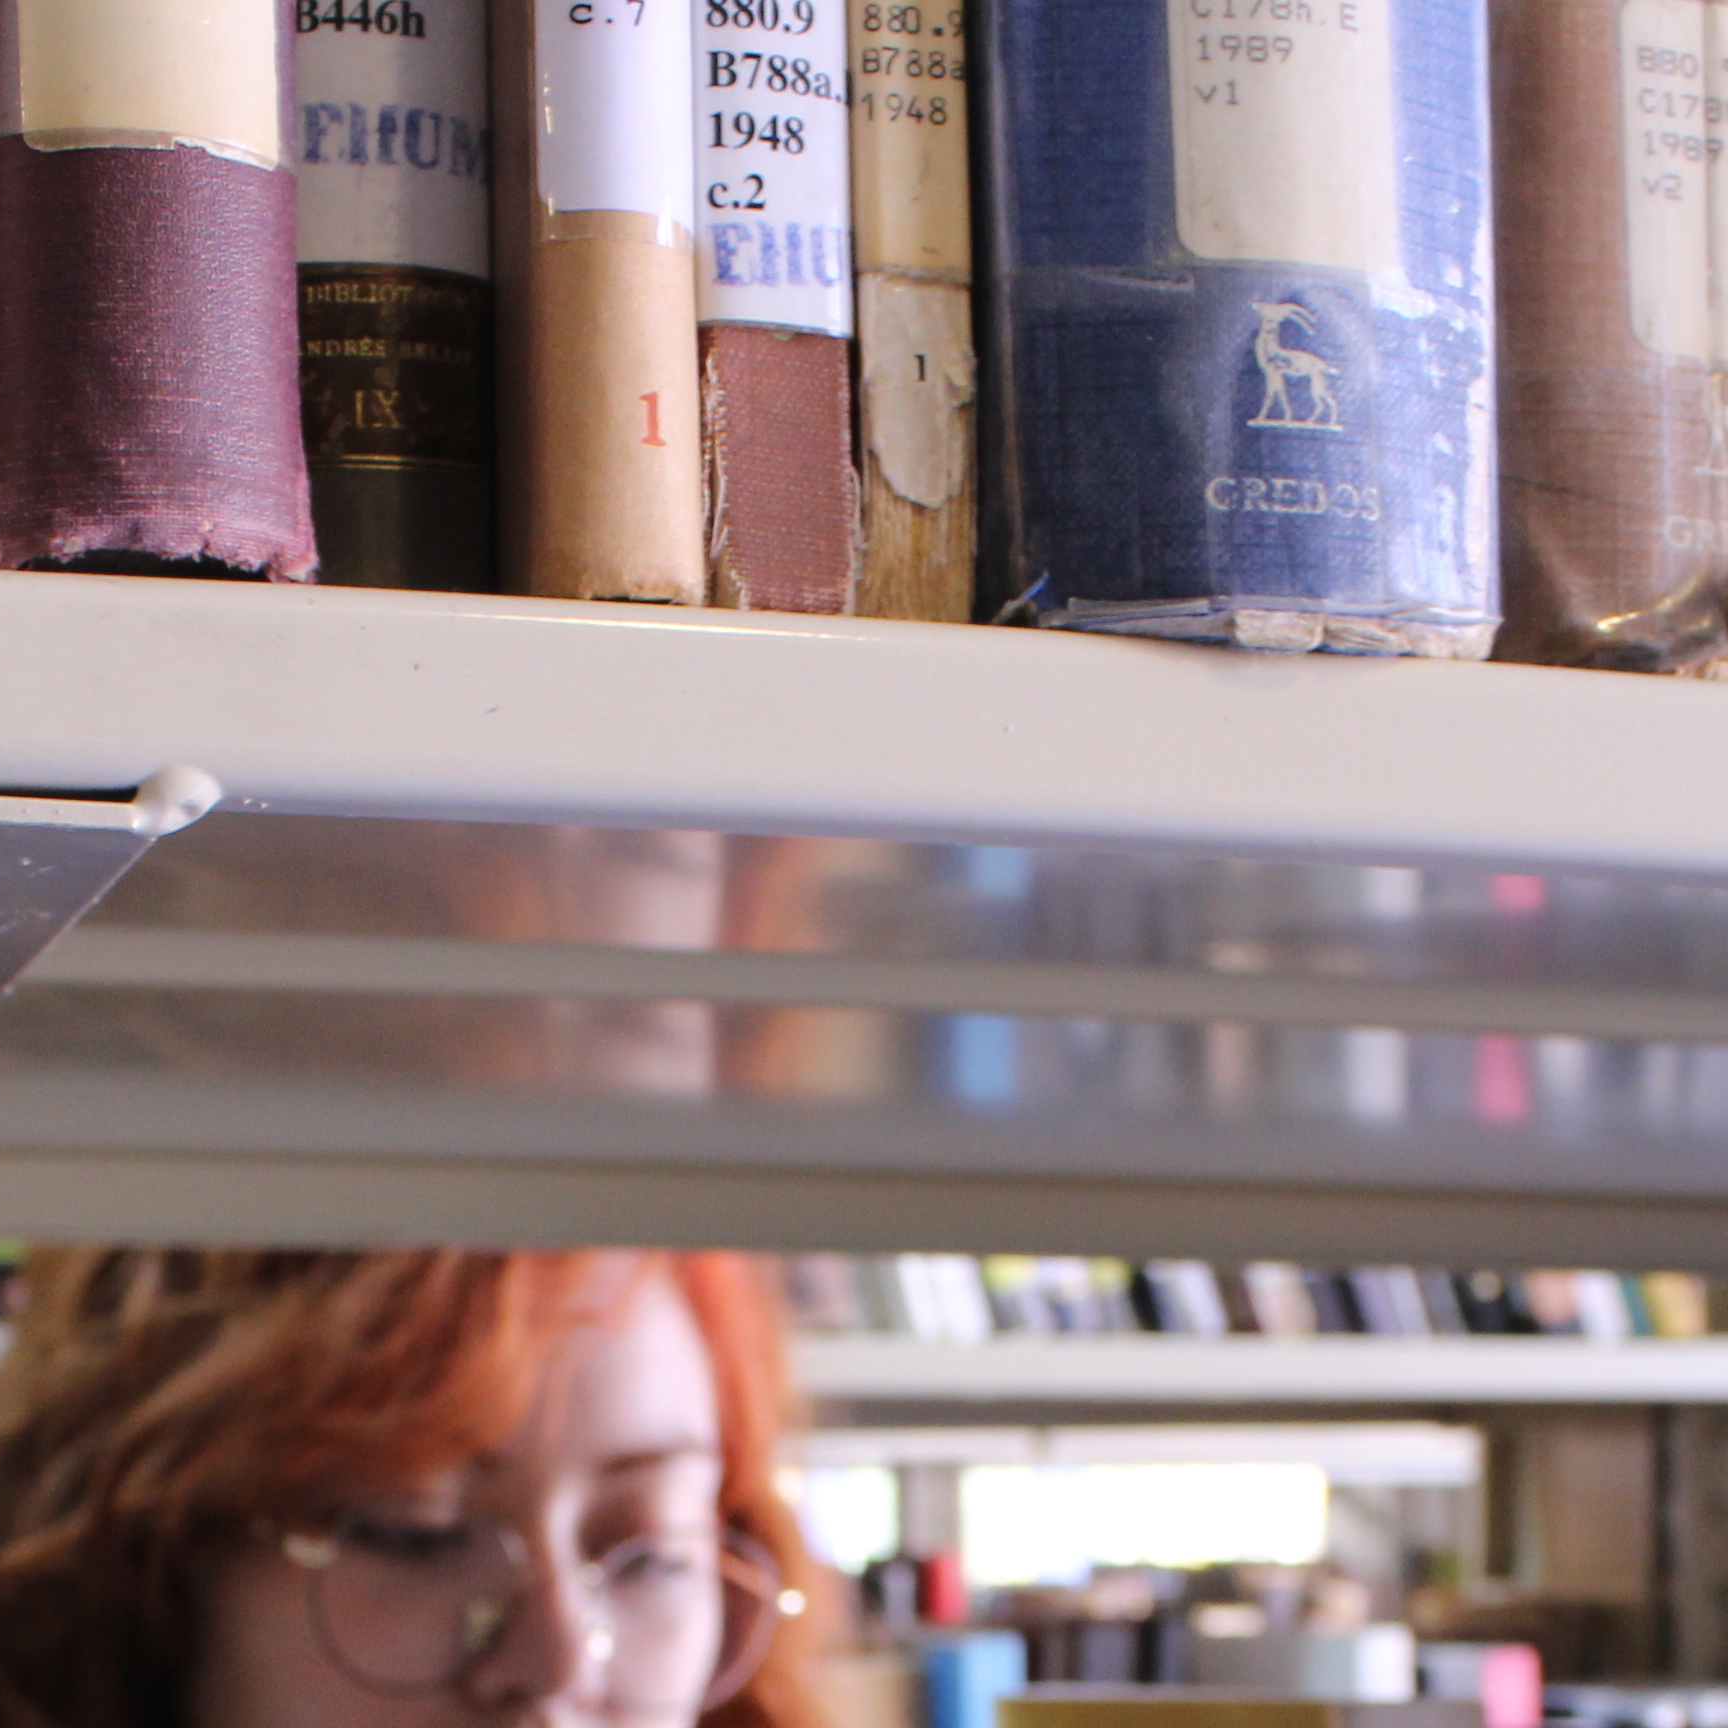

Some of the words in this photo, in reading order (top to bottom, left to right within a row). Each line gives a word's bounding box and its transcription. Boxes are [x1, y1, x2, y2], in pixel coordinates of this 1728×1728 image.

[705, 0, 816, 34] 880.9
[863, 4, 964, 38] 880.9
[1196, 33, 1293, 63] 1989
[860, 92, 949, 126] 1948
[707, 111, 806, 154] 1948
[1642, 129, 1725, 163] 1989
[707, 173, 768, 210] c.2
[301, 335, 387, 358] NDRÉS
[640, 391, 666, 448] 1
[1204, 475, 1381, 522] GREDOS
